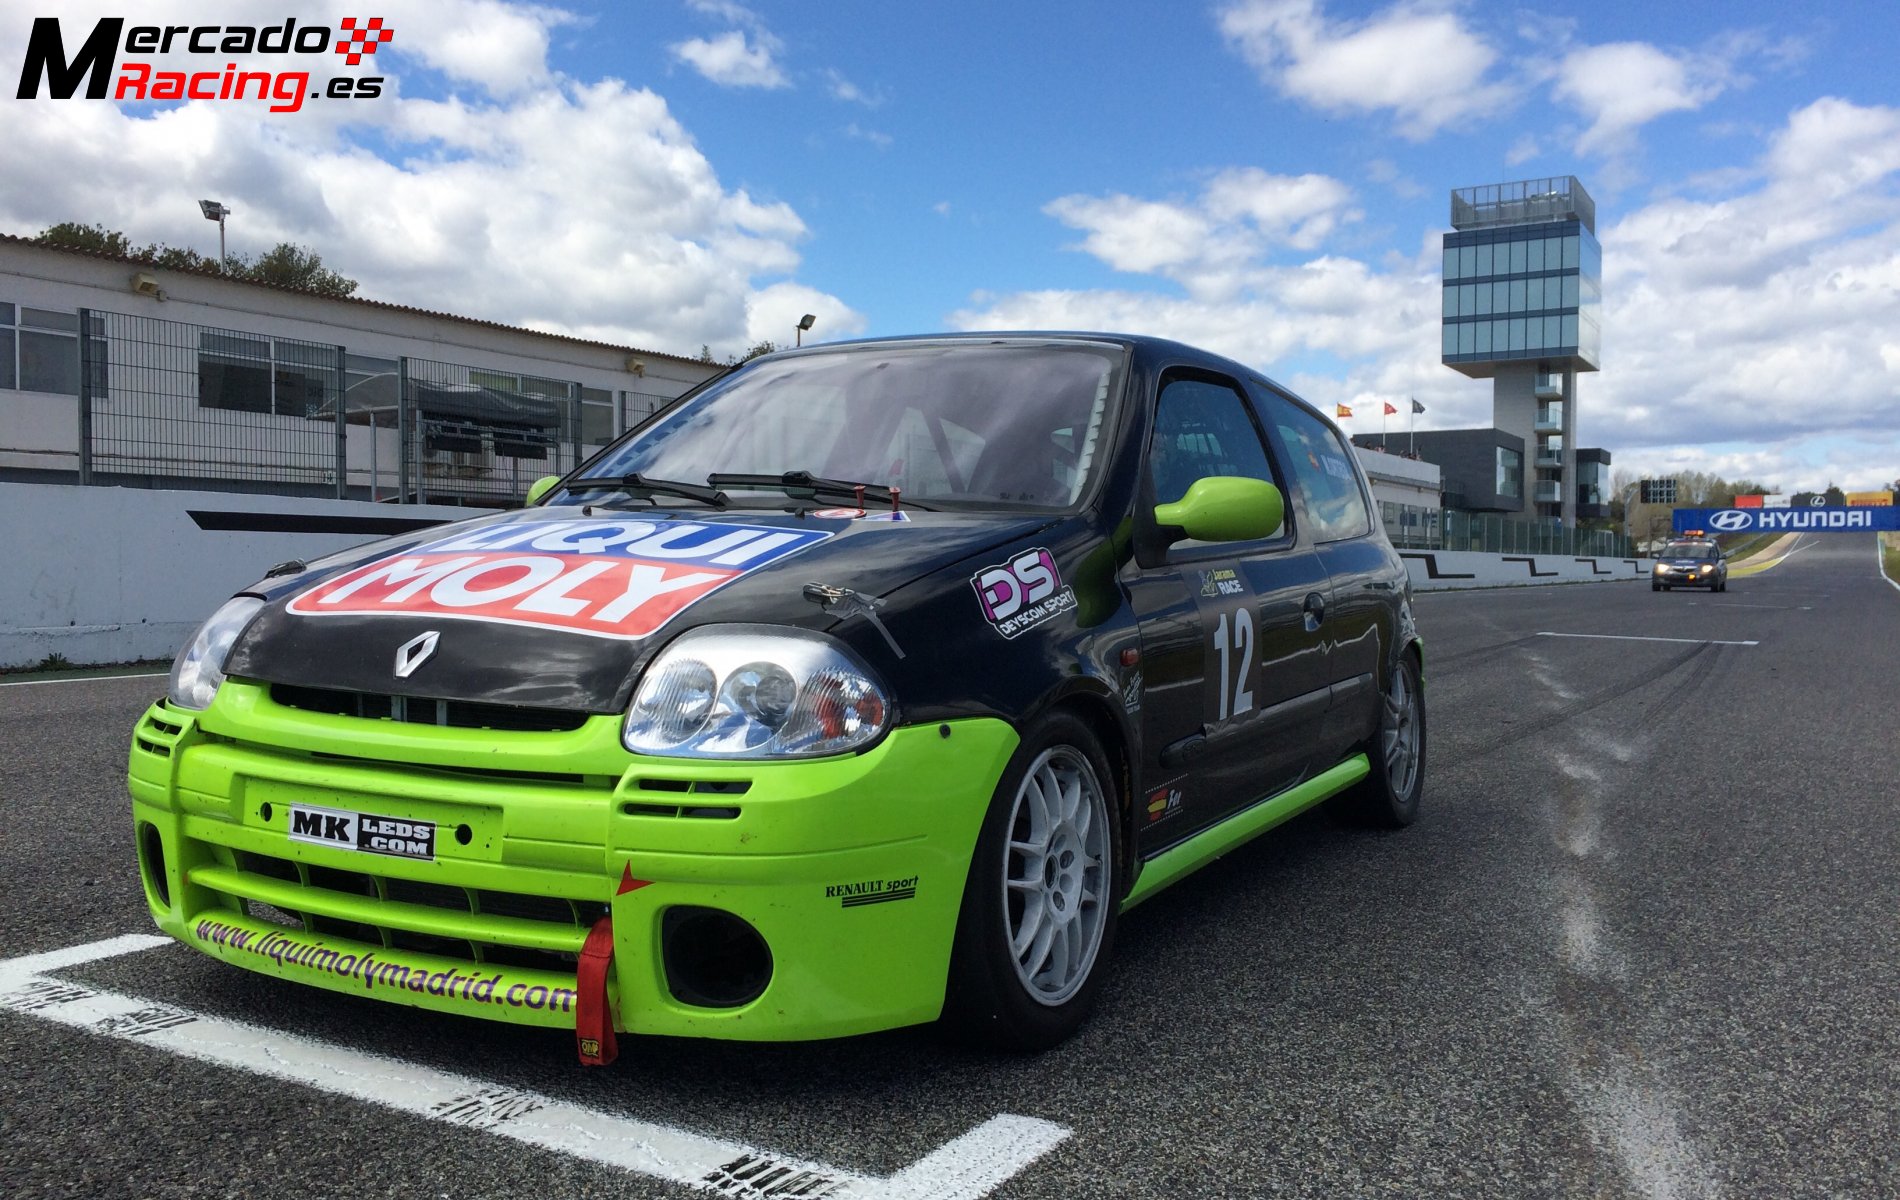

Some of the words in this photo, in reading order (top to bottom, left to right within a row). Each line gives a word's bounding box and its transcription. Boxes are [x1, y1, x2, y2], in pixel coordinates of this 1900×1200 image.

[1759, 510, 1872, 528] HYUNDAI
[428, 520, 805, 566] LIQUI
[317, 555, 733, 624] MOLY
[981, 551, 1055, 621] DS
[1217, 580, 1244, 595] RACE
[999, 605, 1048, 635] DEYSCOM
[1044, 591, 1073, 612] SPORT
[1213, 607, 1254, 721] 12
[293, 810, 350, 842] MK
[361, 818, 431, 840] LEDS
[364, 836, 428, 856] .COM
[825, 880, 883, 898] RENAULT
[886, 875, 919, 892] sport
[196, 917, 578, 1013] www.liquimolymadrid.com
